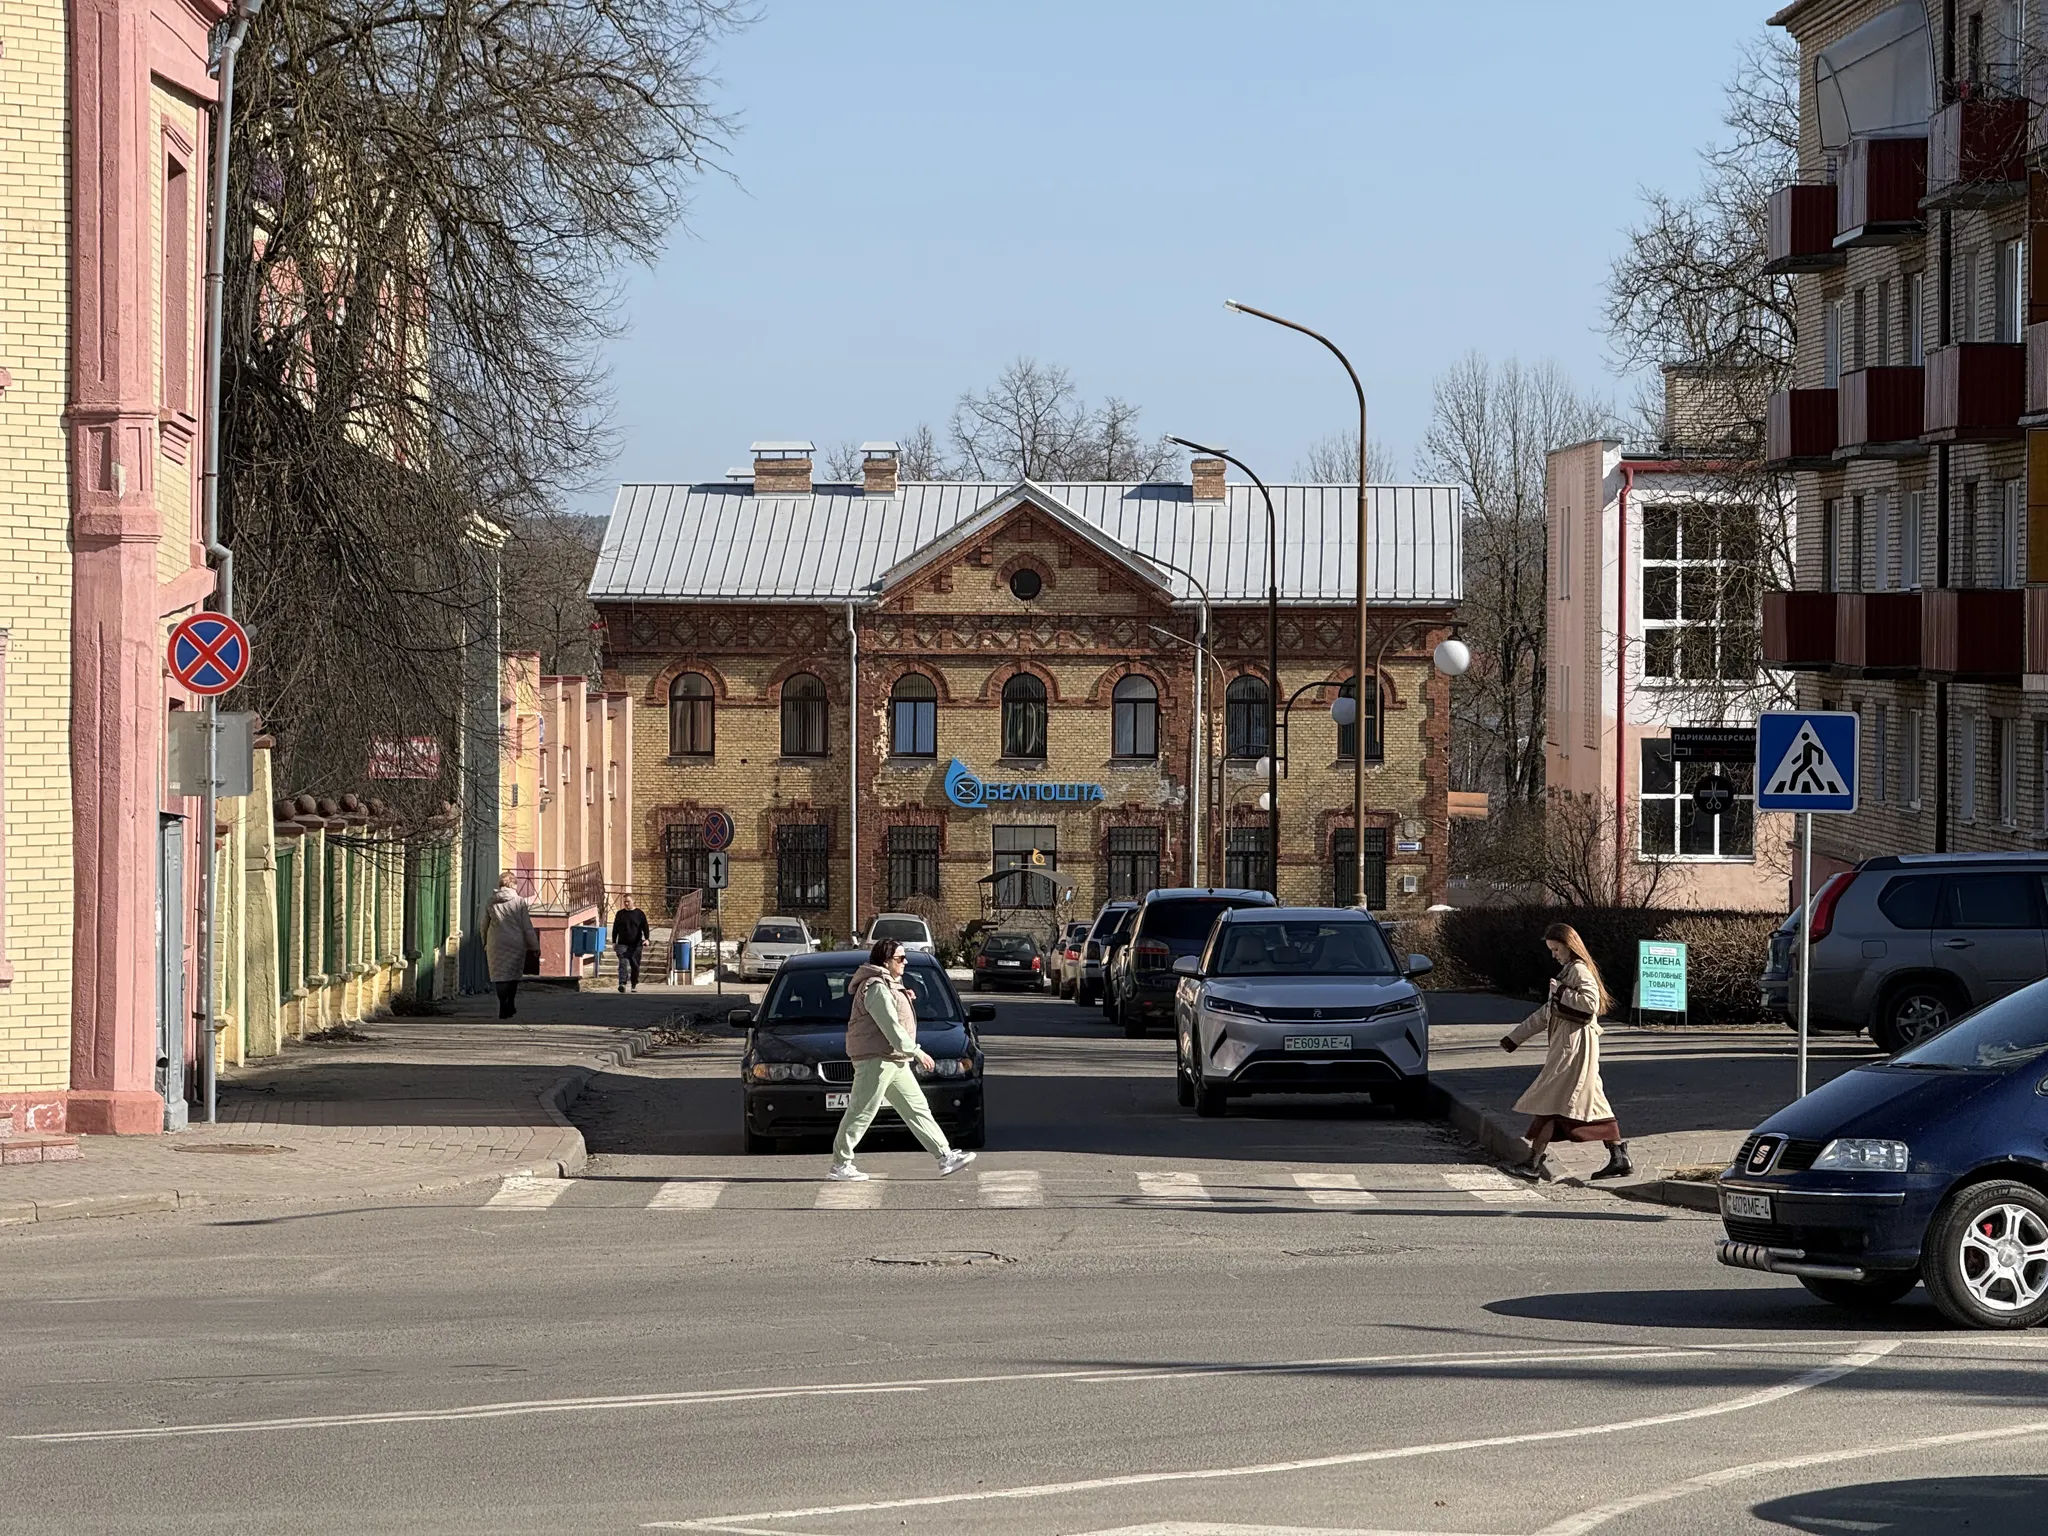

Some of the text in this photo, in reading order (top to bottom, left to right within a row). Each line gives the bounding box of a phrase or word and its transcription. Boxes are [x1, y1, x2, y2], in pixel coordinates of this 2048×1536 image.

[1674, 733, 1756, 742] ПАРИКМАХЕРСКАЯ
[986, 782, 1104, 801] БЕЛПОШТА
[1642, 956, 1681, 966] СЕМЕНА
[1642, 971, 1683, 980] РЫБОЛОВНЫЕ
[1649, 980, 1676, 989] ТОВАРЫ
